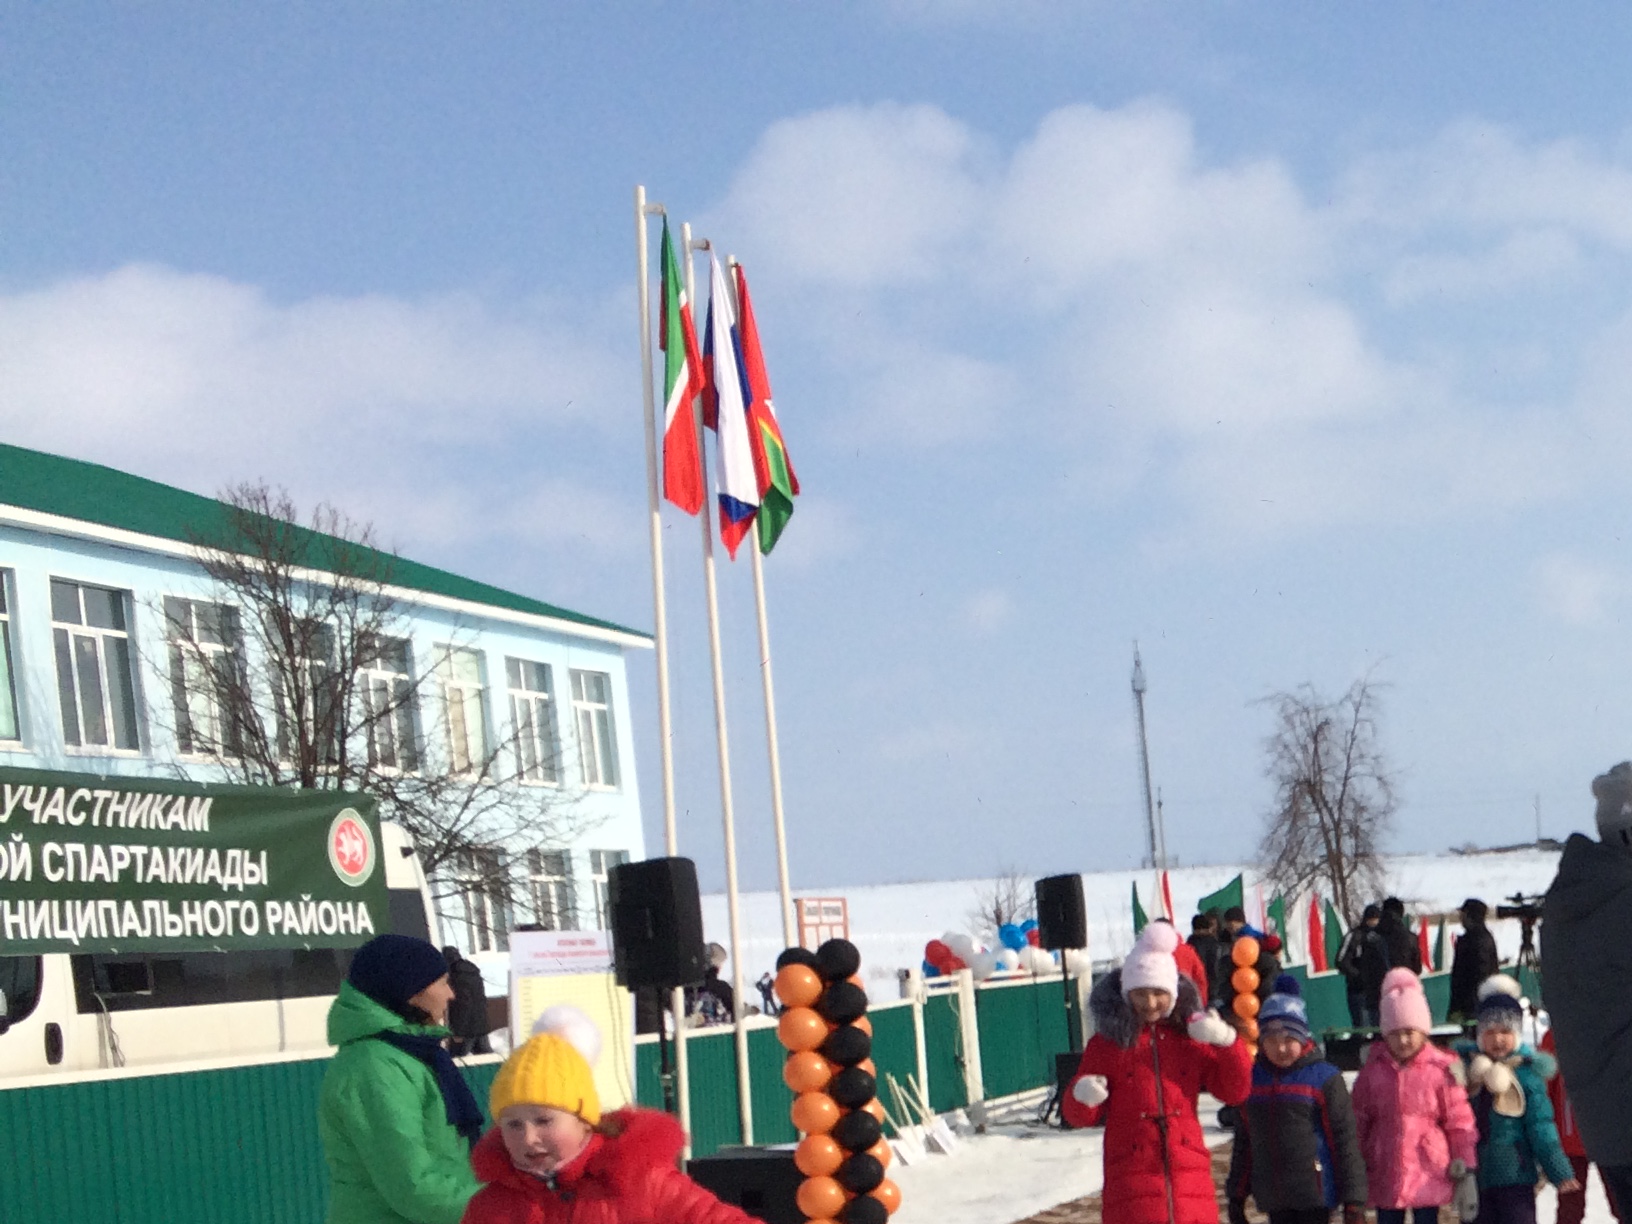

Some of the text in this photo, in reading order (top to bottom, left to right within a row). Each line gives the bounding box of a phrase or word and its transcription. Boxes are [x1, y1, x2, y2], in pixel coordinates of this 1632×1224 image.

[0, 784, 213, 832] УЧАСТНИКАМ
[42, 842, 269, 892] СПАРТАКИАДЫ
[0, 893, 375, 945] НИЦИПАЛЬНОГО РАЙОНА
